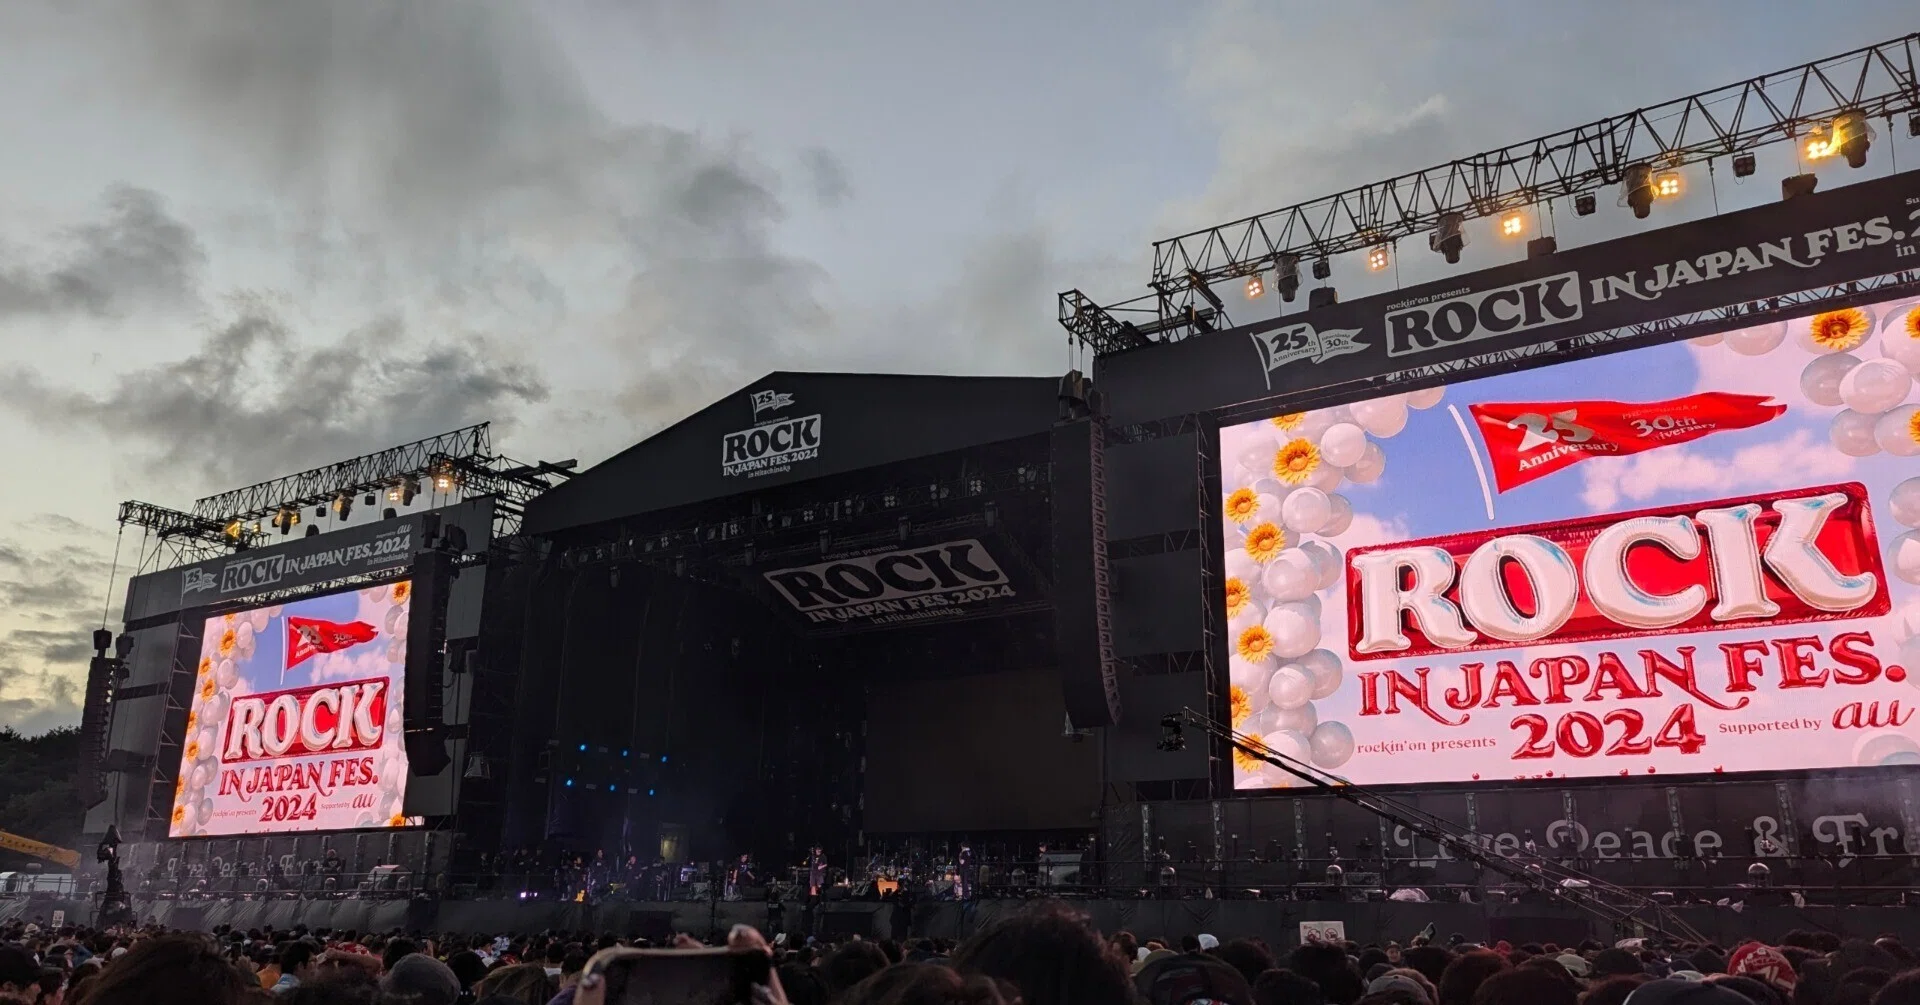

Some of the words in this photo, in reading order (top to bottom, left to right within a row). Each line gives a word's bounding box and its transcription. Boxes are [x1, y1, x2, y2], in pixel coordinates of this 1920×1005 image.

[1896, 244, 1917, 257] in
[1386, 296, 1429, 311] rockin'on
[1431, 287, 1471, 303] presents
[1387, 277, 1578, 355] ROCK
[1589, 271, 1662, 305] IN
[1645, 237, 1821, 292] JAPAN
[1804, 215, 1906, 259] FES.
[1270, 326, 1318, 355] 25th
[1273, 346, 1318, 364] Anniversary
[1325, 338, 1350, 350] 30th
[724, 417, 819, 463] ROCK
[1630, 414, 1698, 438] 30th
[723, 466, 740, 477] IN
[735, 458, 768, 473] JAPAN
[770, 454, 791, 466] FES.
[791, 448, 818, 462] 2024
[1518, 441, 1620, 472] Anniversary
[222, 555, 284, 591] ROCK
[284, 558, 305, 575] IN
[300, 548, 349, 570] JAPAN
[346, 542, 373, 561] FES.
[373, 534, 411, 556] 2024
[770, 543, 1001, 608] ROCK
[1351, 492, 1877, 654] ROCK
[806, 608, 848, 623] IN
[834, 599, 906, 619] JAPAN
[905, 592, 954, 609] FES.
[953, 584, 1016, 605] 2024
[887, 606, 965, 623] Hitachinaka
[1357, 667, 1471, 727] IN
[1444, 645, 1750, 711] JAPAN
[1718, 631, 1907, 693] FES.
[223, 680, 385, 761] ROCK
[1510, 703, 1707, 760] 2024
[1718, 718, 1800, 734] Supported
[1802, 717, 1823, 732] by
[1832, 699, 1916, 730] au
[1357, 740, 1427, 755] rockin'on
[1431, 736, 1497, 753] presents
[218, 769, 252, 802] IN
[246, 761, 333, 797] JAPAN
[327, 757, 379, 788] FES.
[259, 793, 318, 822] 2024
[352, 793, 377, 809] au
[1752, 815, 1797, 858] &
